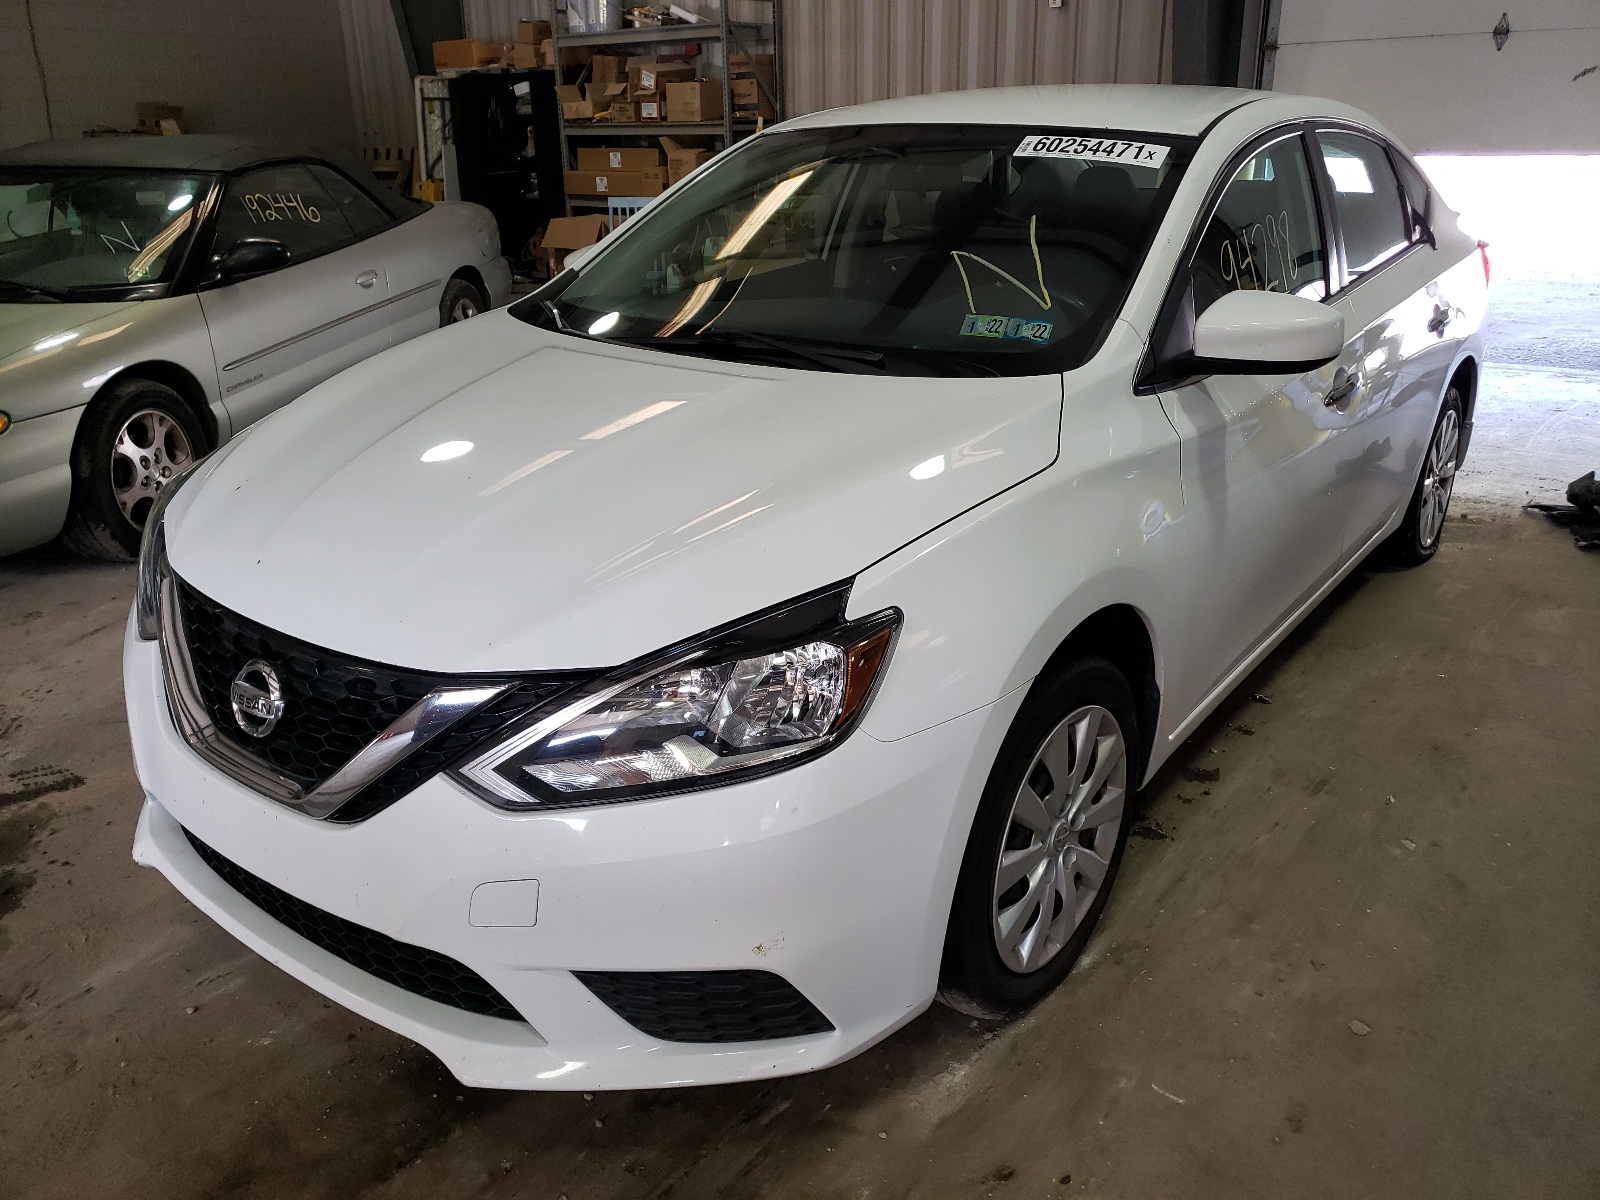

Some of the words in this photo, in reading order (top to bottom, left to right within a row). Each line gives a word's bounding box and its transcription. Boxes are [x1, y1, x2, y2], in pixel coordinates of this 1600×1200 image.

[240, 193, 321, 224] 192446
[987, 318, 1004, 334] 22
[1032, 323, 1048, 339] 22
